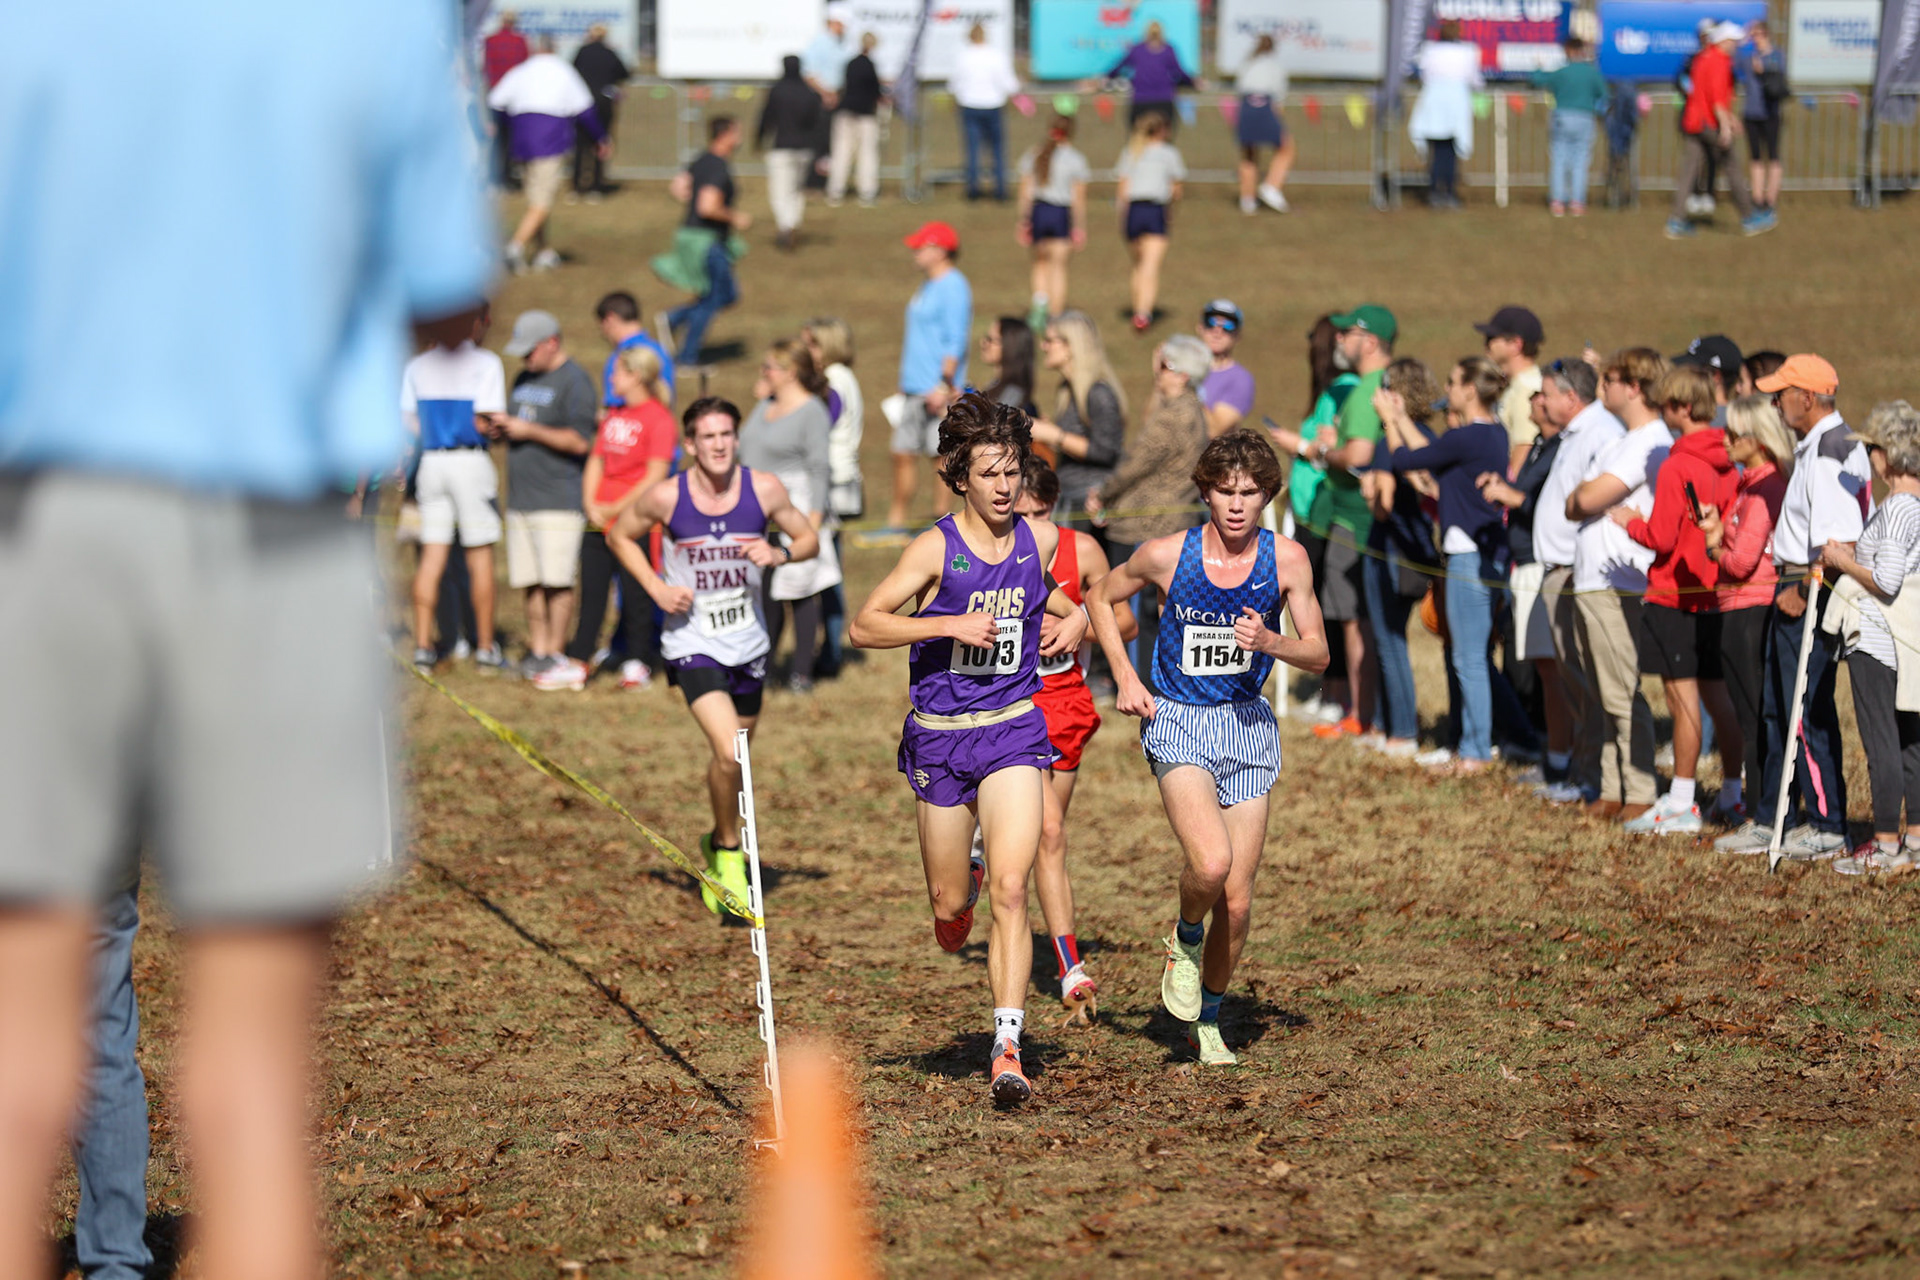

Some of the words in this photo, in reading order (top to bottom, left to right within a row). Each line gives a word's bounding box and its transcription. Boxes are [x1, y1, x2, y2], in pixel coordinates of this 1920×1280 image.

[687, 546, 748, 565] FATHE
[696, 567, 749, 589] RYAN
[966, 587, 1026, 618] CBHS
[710, 605, 745, 628] 1101
[960, 640, 1015, 667] 1073
[1190, 645, 1245, 667] 1154
